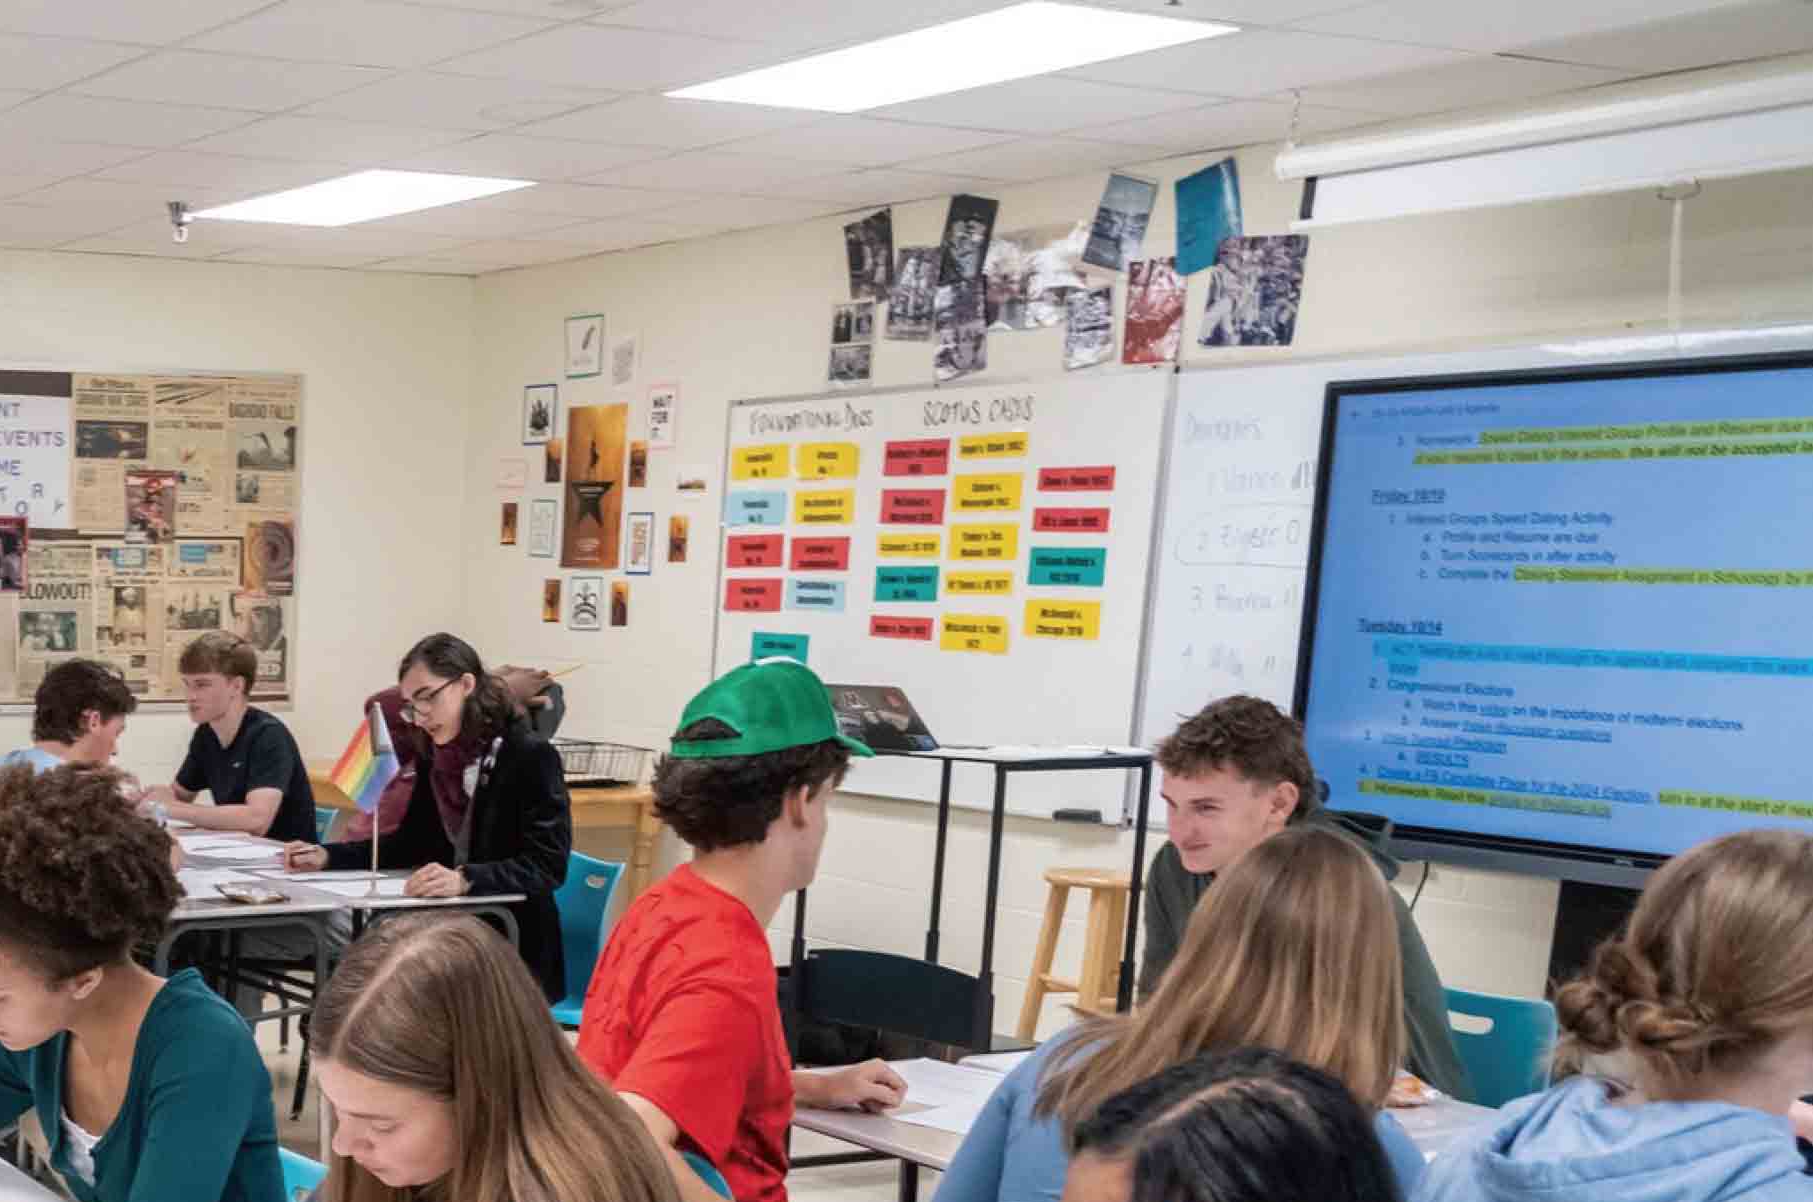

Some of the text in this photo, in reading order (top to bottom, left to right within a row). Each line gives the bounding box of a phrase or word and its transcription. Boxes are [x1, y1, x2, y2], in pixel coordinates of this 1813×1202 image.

[1449, 512, 1488, 527] Groups
[1491, 512, 1528, 527] Speed
[1530, 512, 1568, 528] Dating
[1572, 511, 1616, 527] Activity
[1441, 530, 1477, 544] Profile
[1479, 530, 1501, 544] and
[1503, 530, 1550, 544] Resume
[1553, 533, 1573, 544] are
[1575, 532, 1600, 544] due
[1440, 549, 1467, 562] Turn
[1546, 549, 1573, 562] after
[1577, 550, 1617, 564] activity
[1437, 567, 1489, 581] Complete
[1492, 568, 1509, 580] the
[1465, 682, 1516, 697] Elections
[1715, 796, 1736, 810] the
